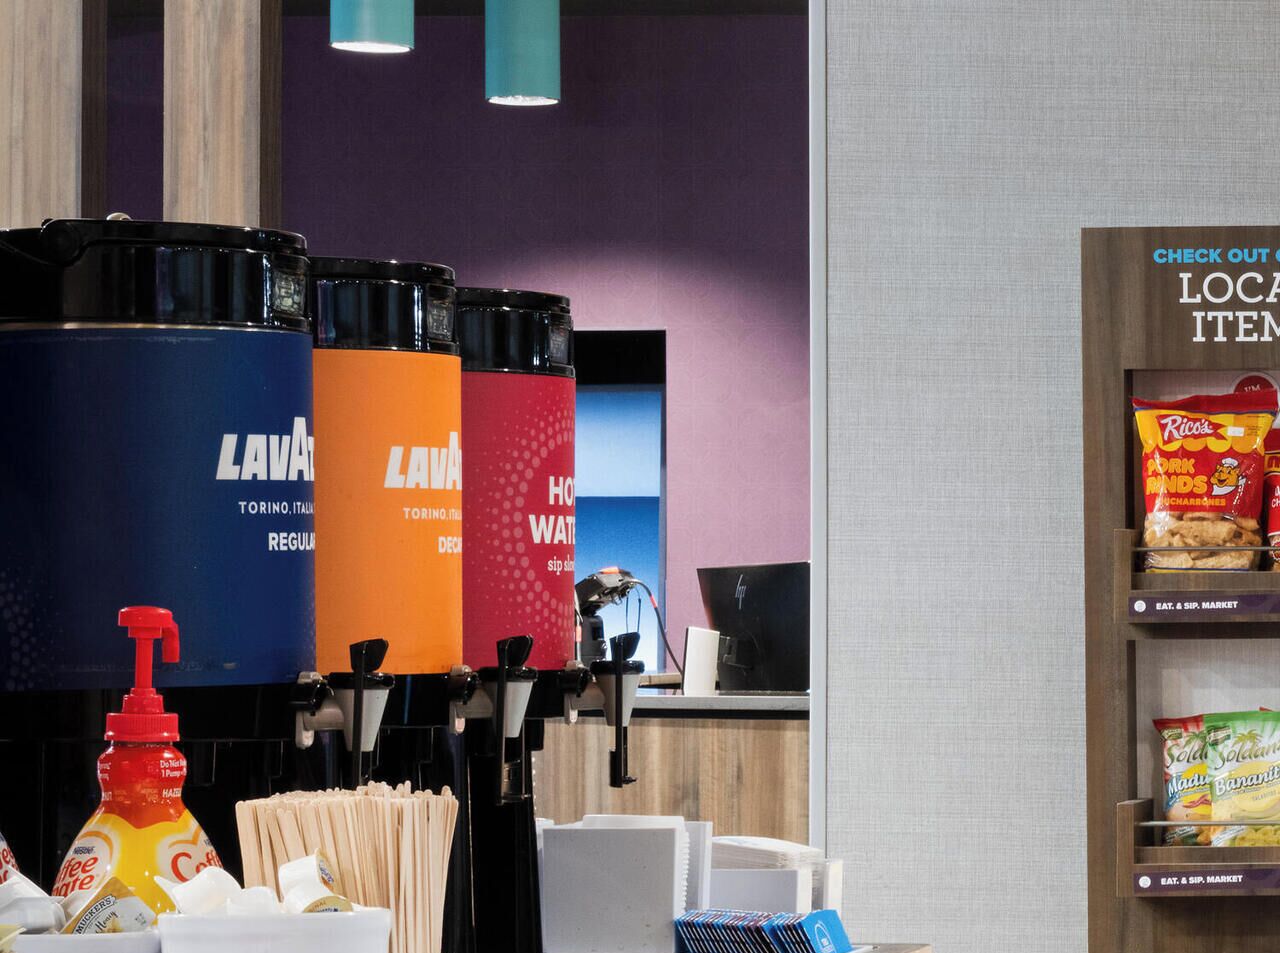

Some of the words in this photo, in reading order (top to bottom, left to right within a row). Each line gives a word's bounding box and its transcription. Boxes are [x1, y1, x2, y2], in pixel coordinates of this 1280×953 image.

[1153, 248, 1223, 264] CHECK
[1227, 248, 1270, 264] OUT
[1160, 414, 1213, 440] Rico's
[384, 432, 462, 491] LAVA
[1147, 457, 1196, 475] PORK
[548, 555, 564, 575] sip
[1156, 602, 1175, 610] EAT.
[1176, 602, 1183, 610] &
[1184, 602, 1200, 610] SIP.
[1202, 601, 1239, 609] MARKET
[1161, 877, 1180, 885] EAT.
[1181, 877, 1188, 885] &
[1189, 876, 1205, 884] SIP.
[1207, 875, 1243, 884] MARKET
